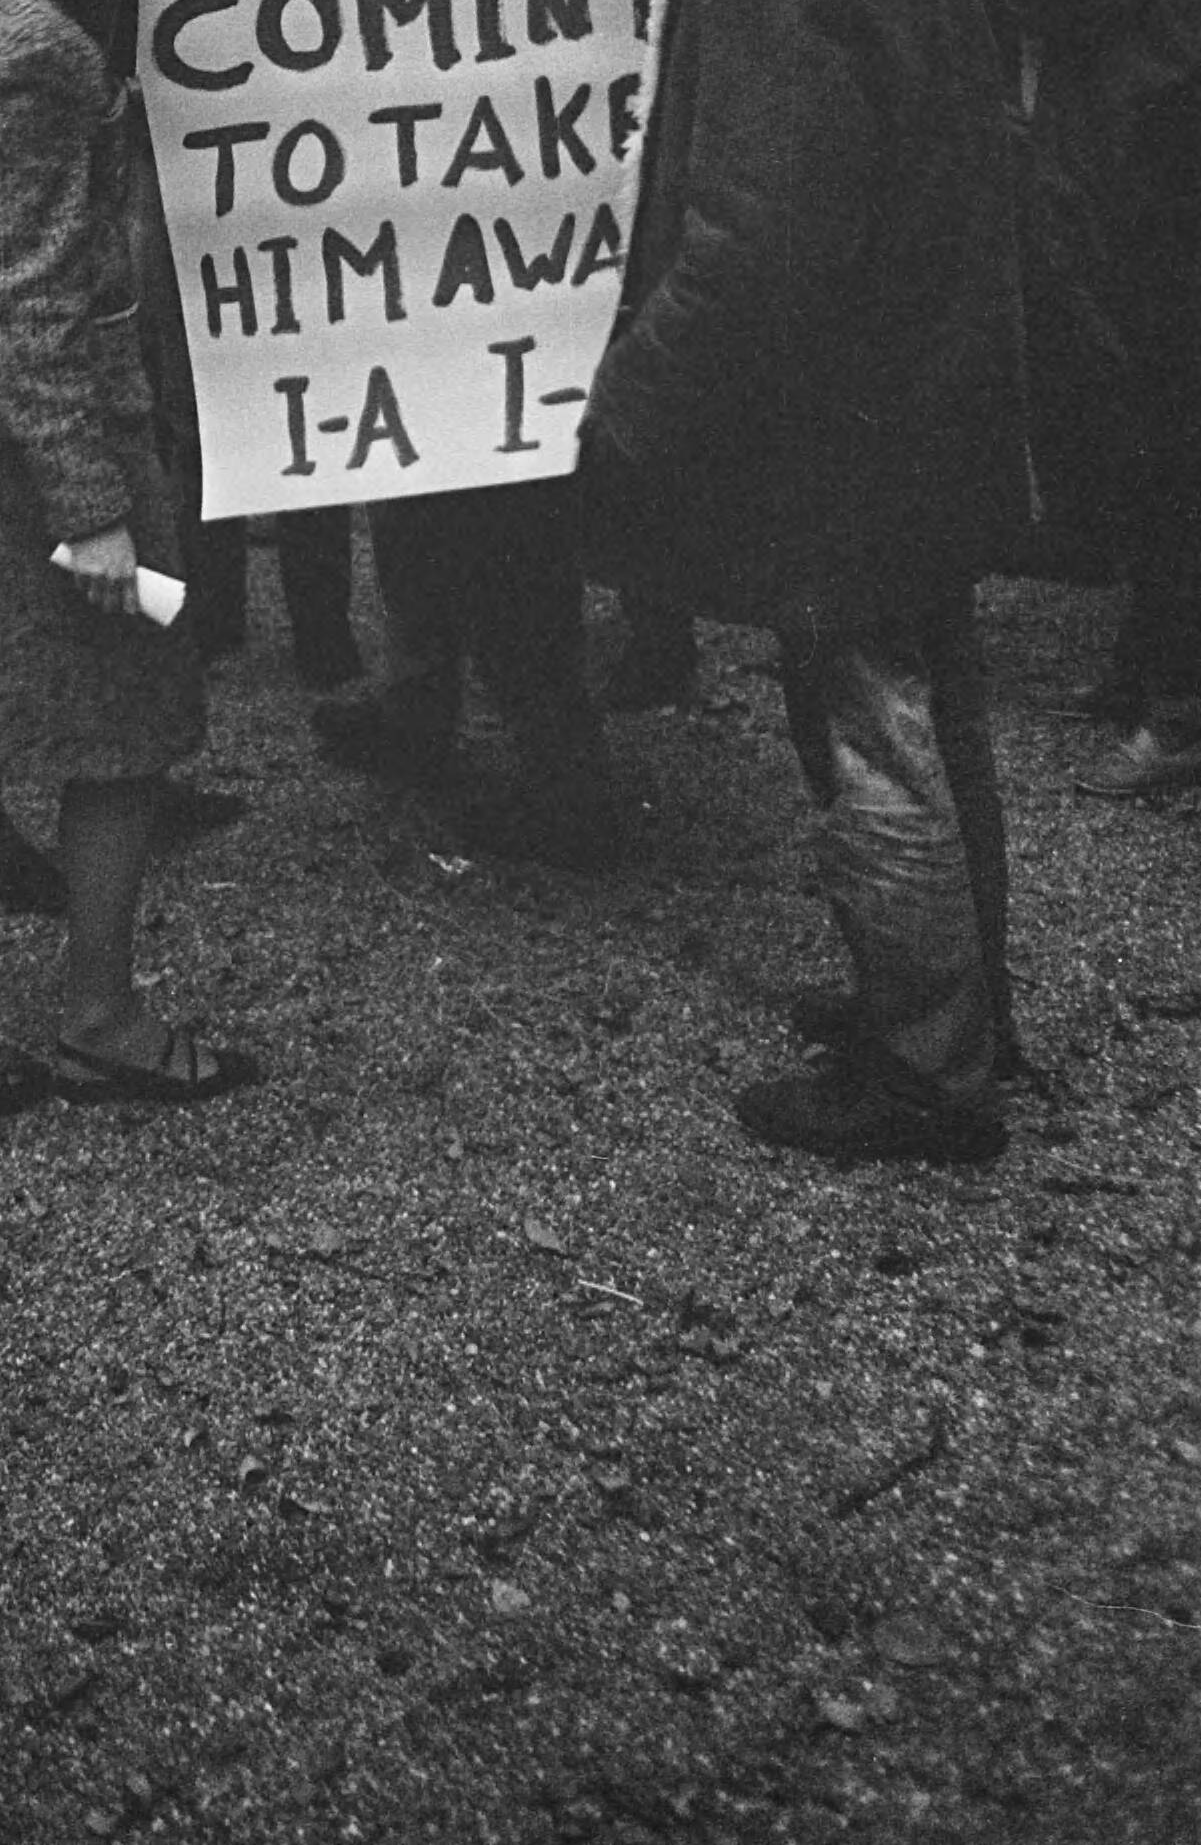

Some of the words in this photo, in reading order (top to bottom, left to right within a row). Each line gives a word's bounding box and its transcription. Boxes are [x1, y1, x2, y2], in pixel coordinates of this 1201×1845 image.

[182, 117, 346, 218] TO
[201, 219, 408, 338] HIM
[273, 365, 421, 476] I-A
